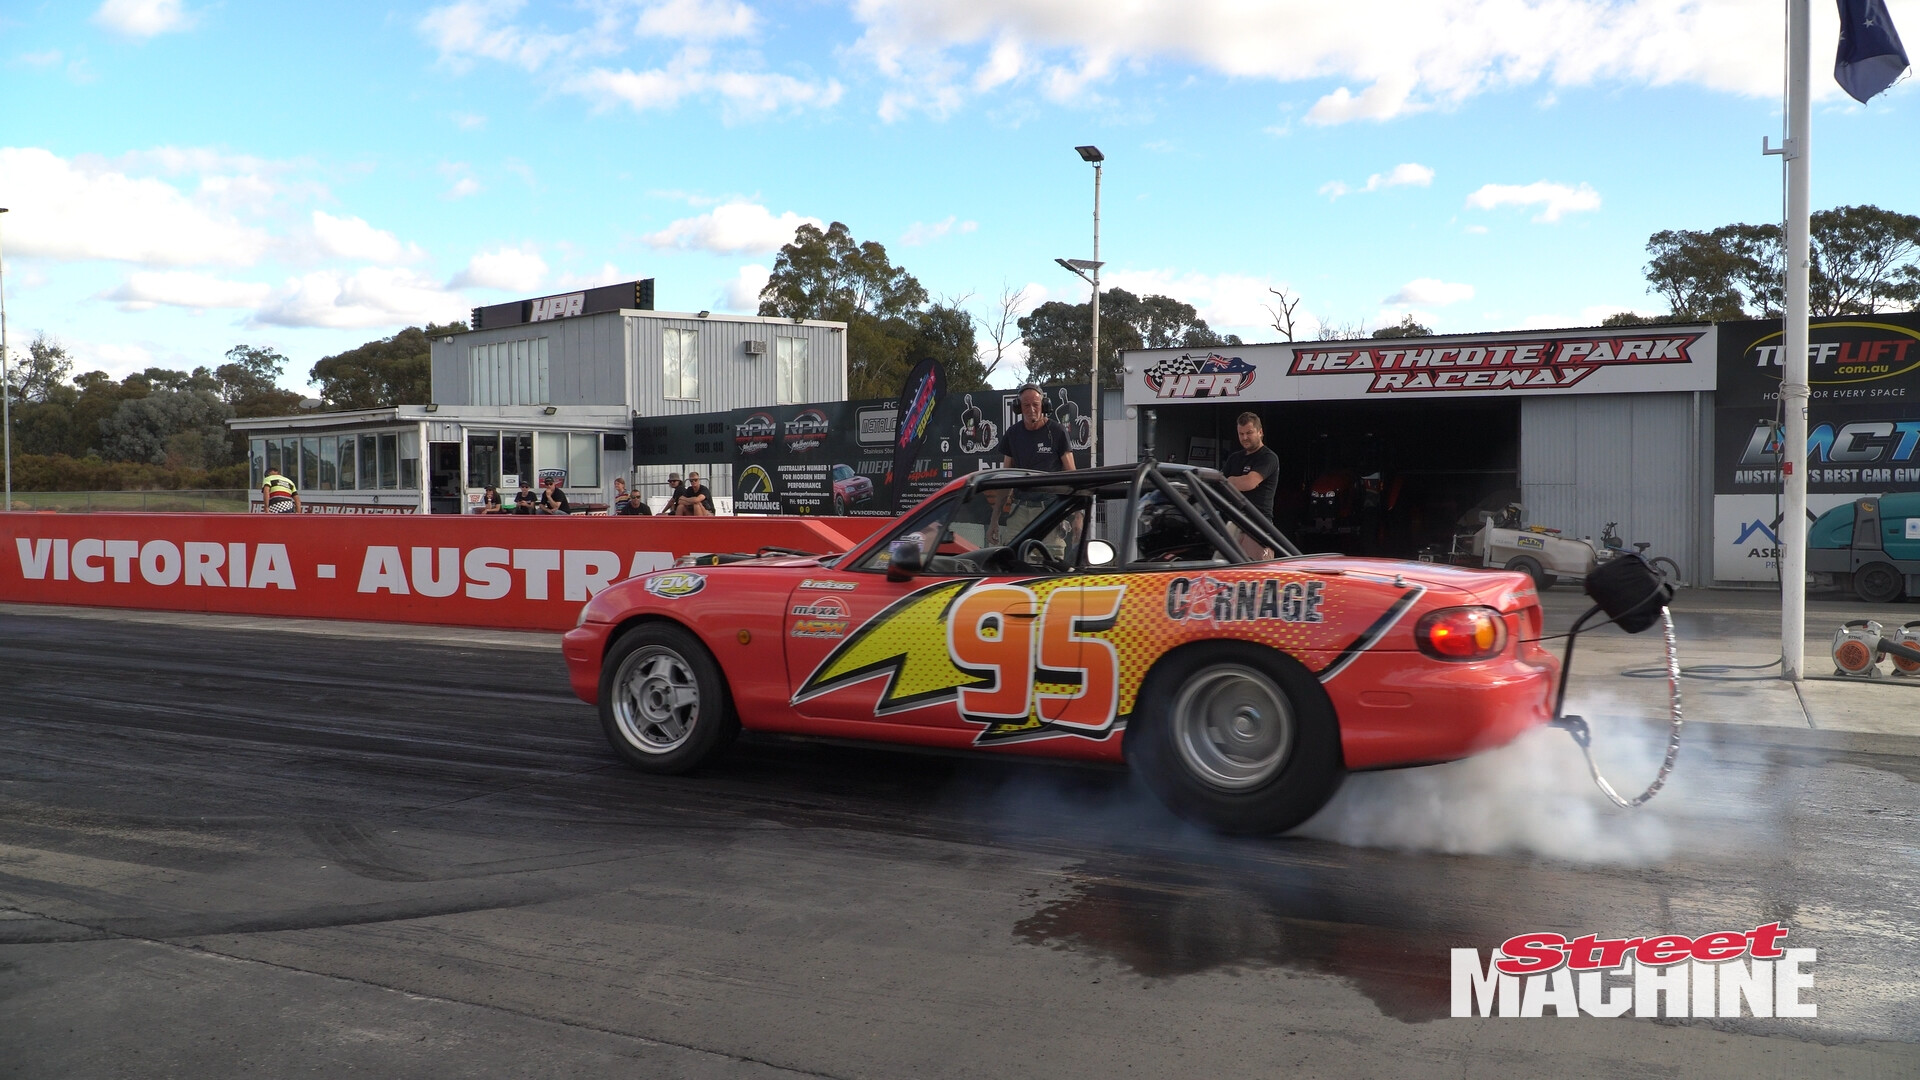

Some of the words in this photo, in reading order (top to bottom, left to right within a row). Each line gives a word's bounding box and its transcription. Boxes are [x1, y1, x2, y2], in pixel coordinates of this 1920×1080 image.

[530, 292, 585, 322] HPR
[1297, 344, 1545, 371] HEATHCOTE
[1557, 338, 1692, 362] PARK
[1834, 365, 1889, 375] .com.au
[1156, 373, 1242, 398] HPR
[1375, 366, 1590, 390] RACEWAY
[1833, 390, 1866, 398] EVERY
[1870, 388, 1906, 397] SPACE
[735, 422, 776, 437] RPM
[784, 419, 829, 435] RPM
[777, 464, 806, 472] AUSTRALIA'S
[1823, 469, 1859, 483] BEST
[1862, 469, 1891, 482] CAR
[743, 492, 769, 501] DONTEX
[735, 501, 780, 511] PERFORMANCE
[1747, 548, 1785, 558] ASB
[15, 537, 296, 591] VICTORIA
[357, 546, 700, 602] AUSTRA
[1167, 574, 1325, 627] CARNAGE
[792, 606, 839, 616] MAXX
[947, 584, 1127, 731] 95
